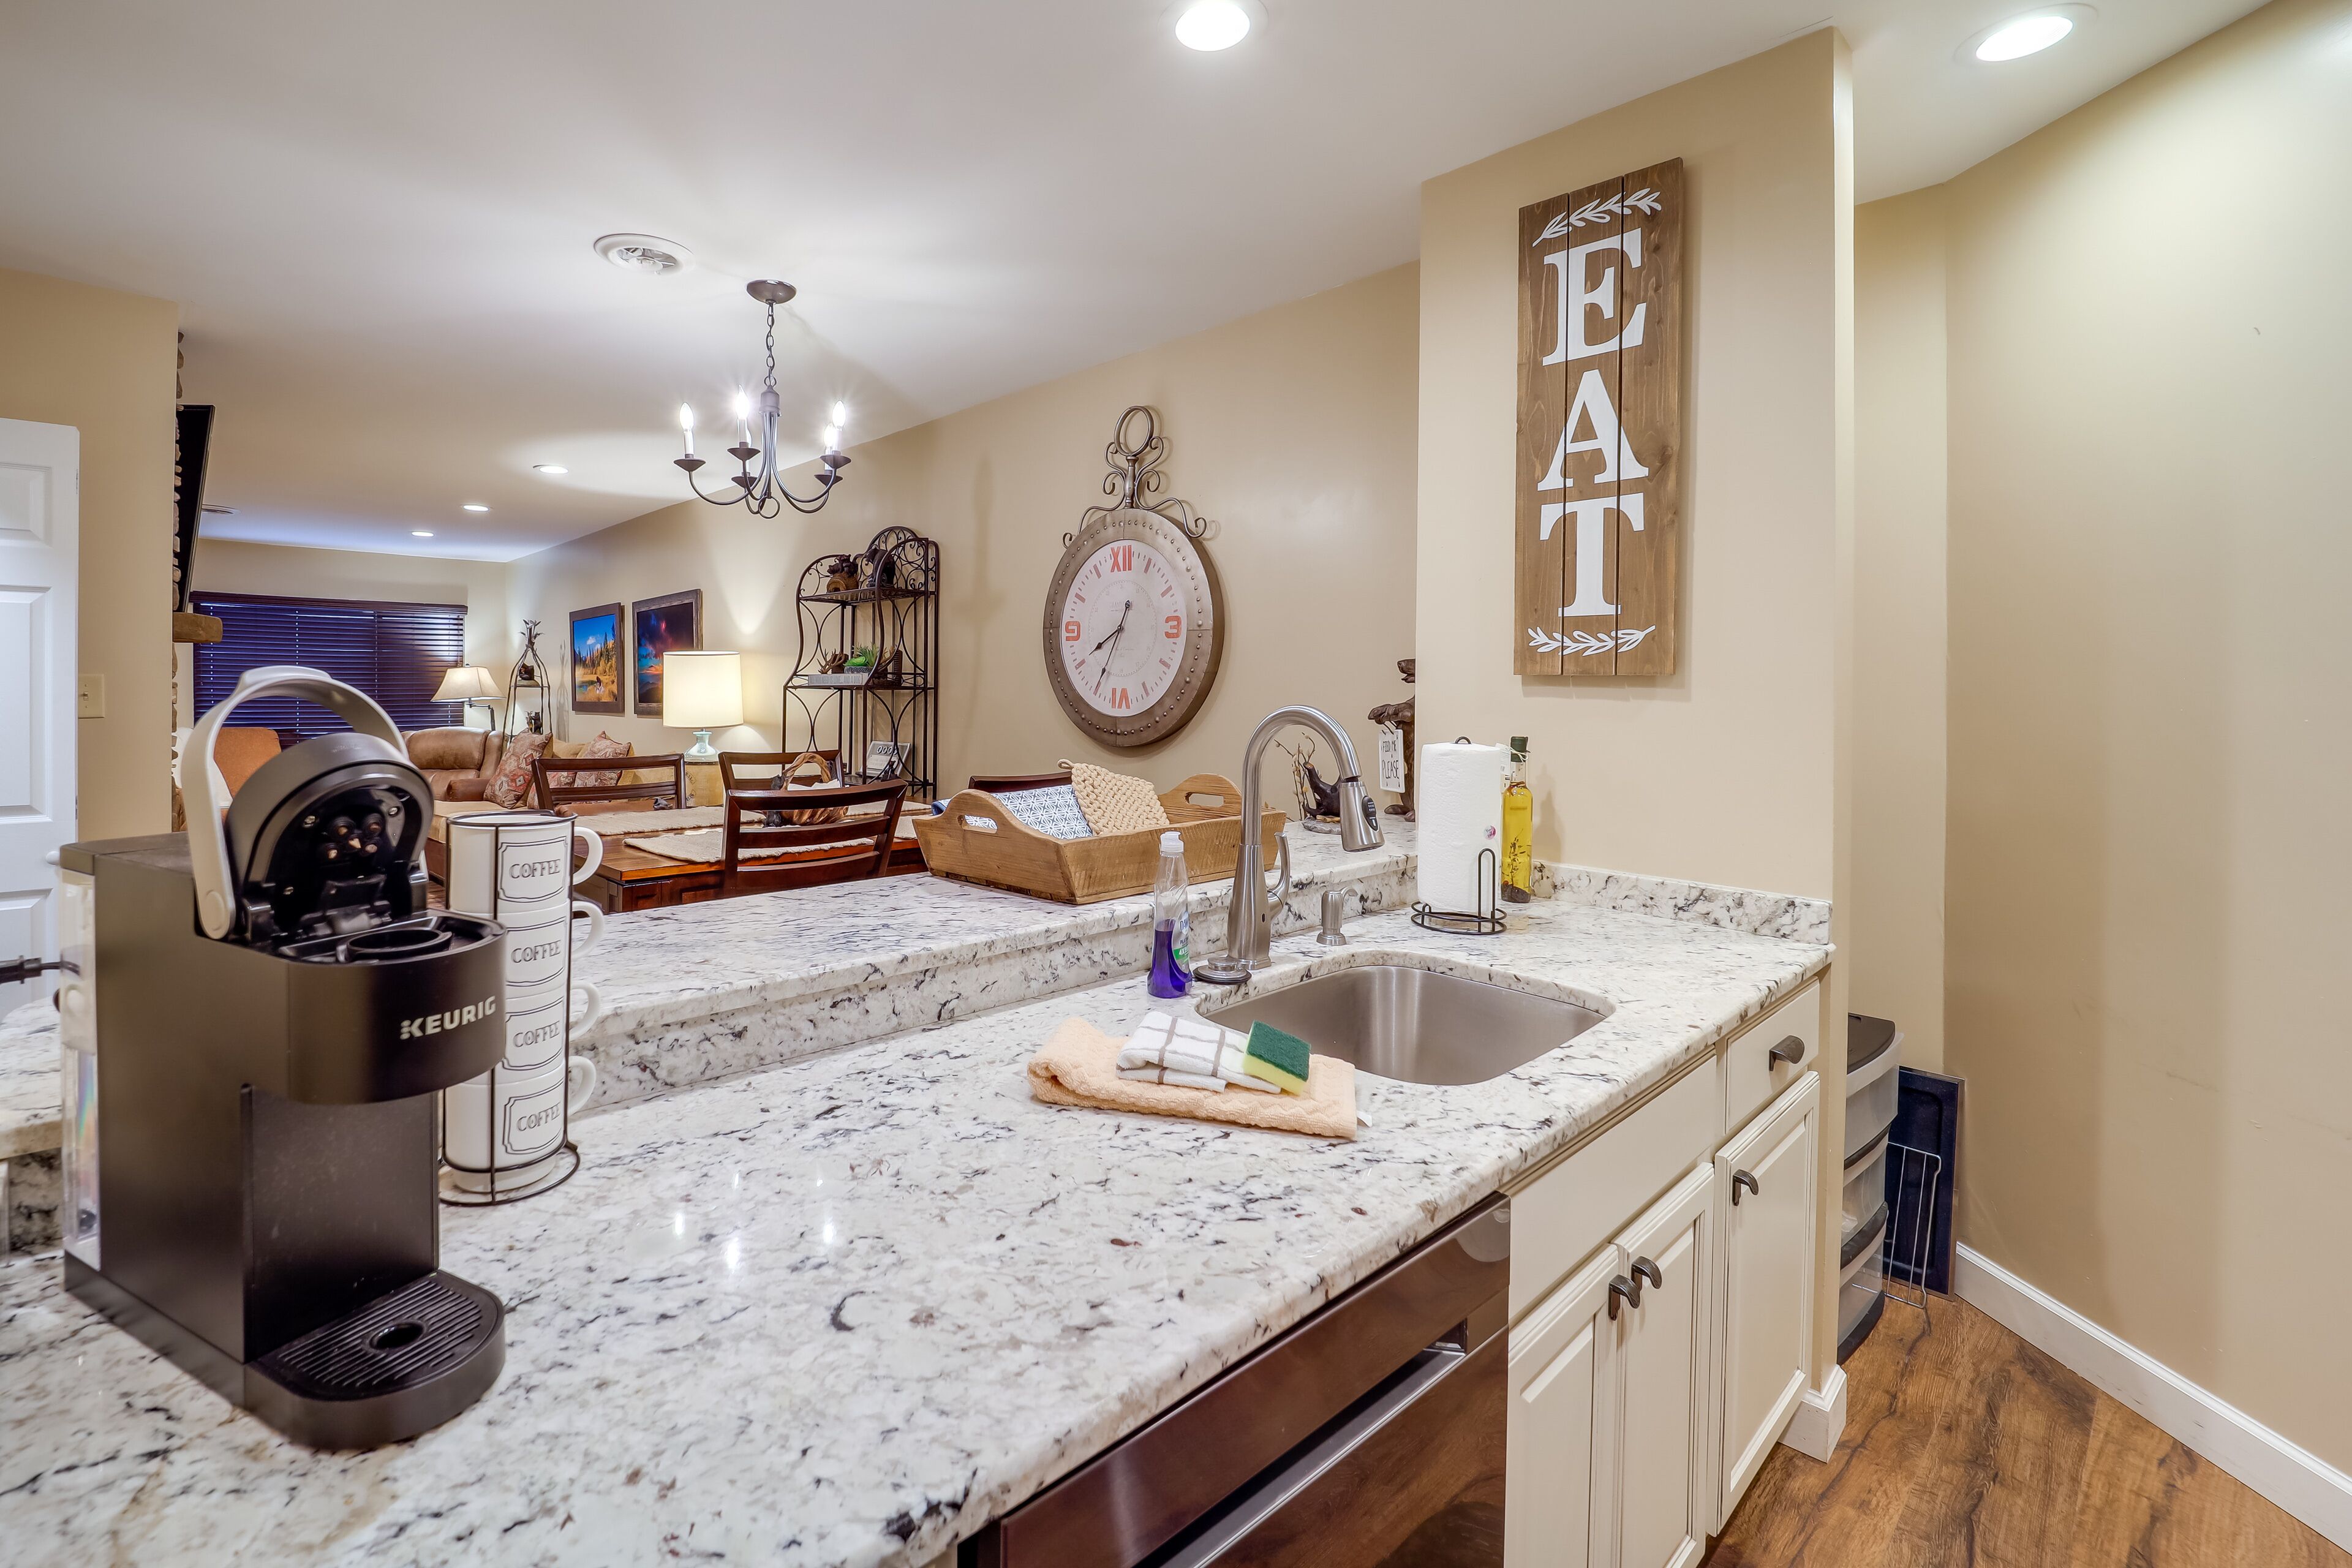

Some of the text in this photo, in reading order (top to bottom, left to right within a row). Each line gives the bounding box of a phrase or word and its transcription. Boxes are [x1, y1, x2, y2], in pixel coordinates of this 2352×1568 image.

[1538, 227, 1649, 617] EAT
[1110, 545, 1132, 573] XII
[1065, 620, 1081, 641] 9
[1164, 615, 1182, 639] 3
[1382, 740, 1391, 752] FEED
[1382, 760, 1400, 779] PLEASE
[509, 859, 560, 879] COFFEE
[510, 940, 561, 963] COFFEE
[399, 995, 496, 1040] KEURIG
[513, 1020, 560, 1048] COFFEE
[516, 1101, 561, 1132] COFFEE
